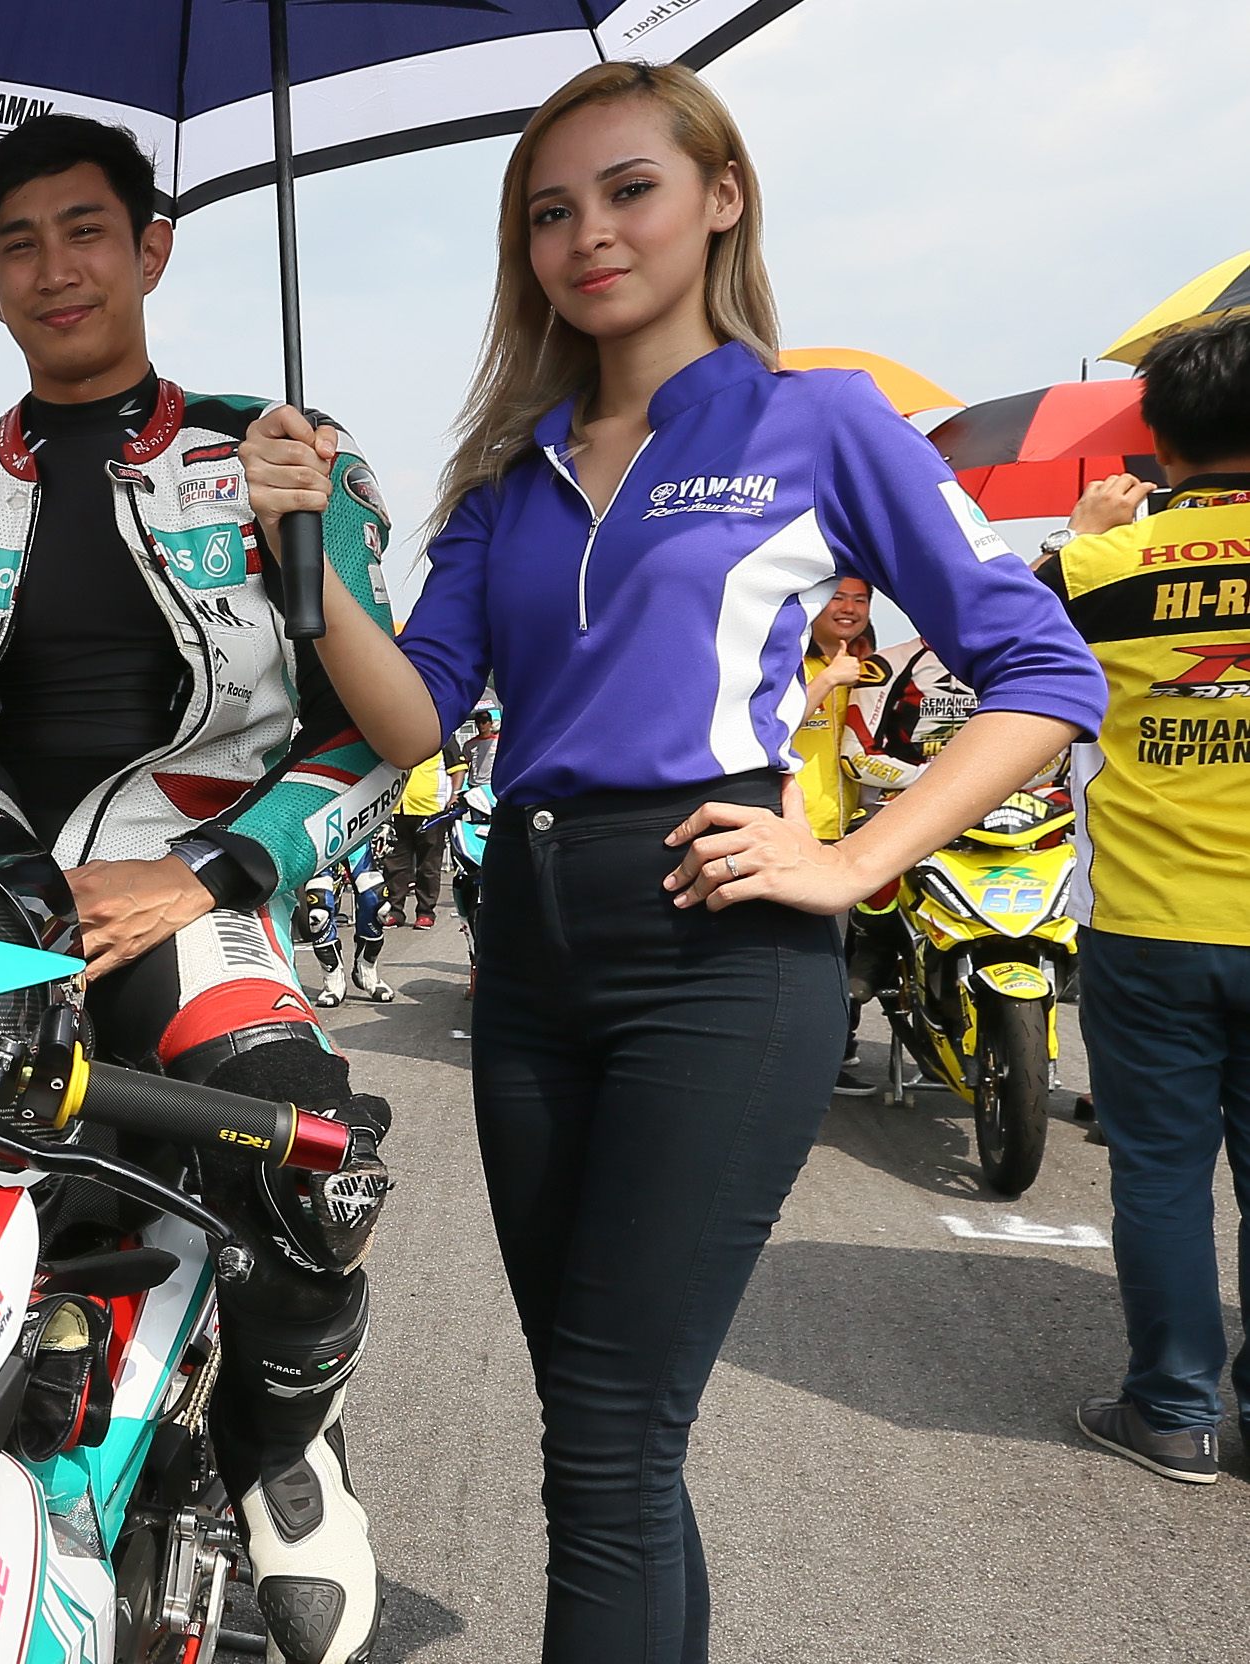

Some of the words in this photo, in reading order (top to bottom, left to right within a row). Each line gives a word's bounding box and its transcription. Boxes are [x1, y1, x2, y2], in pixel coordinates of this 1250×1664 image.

[179, 480, 206, 496] uma
[678, 474, 777, 501] YAMAHA
[181, 491, 215, 507] racing
[226, 681, 253, 703] Racing
[851, 752, 905, 783] HI-REV
[980, 887, 1044, 914] 65
[261, 1359, 302, 1376] RT-RACE
